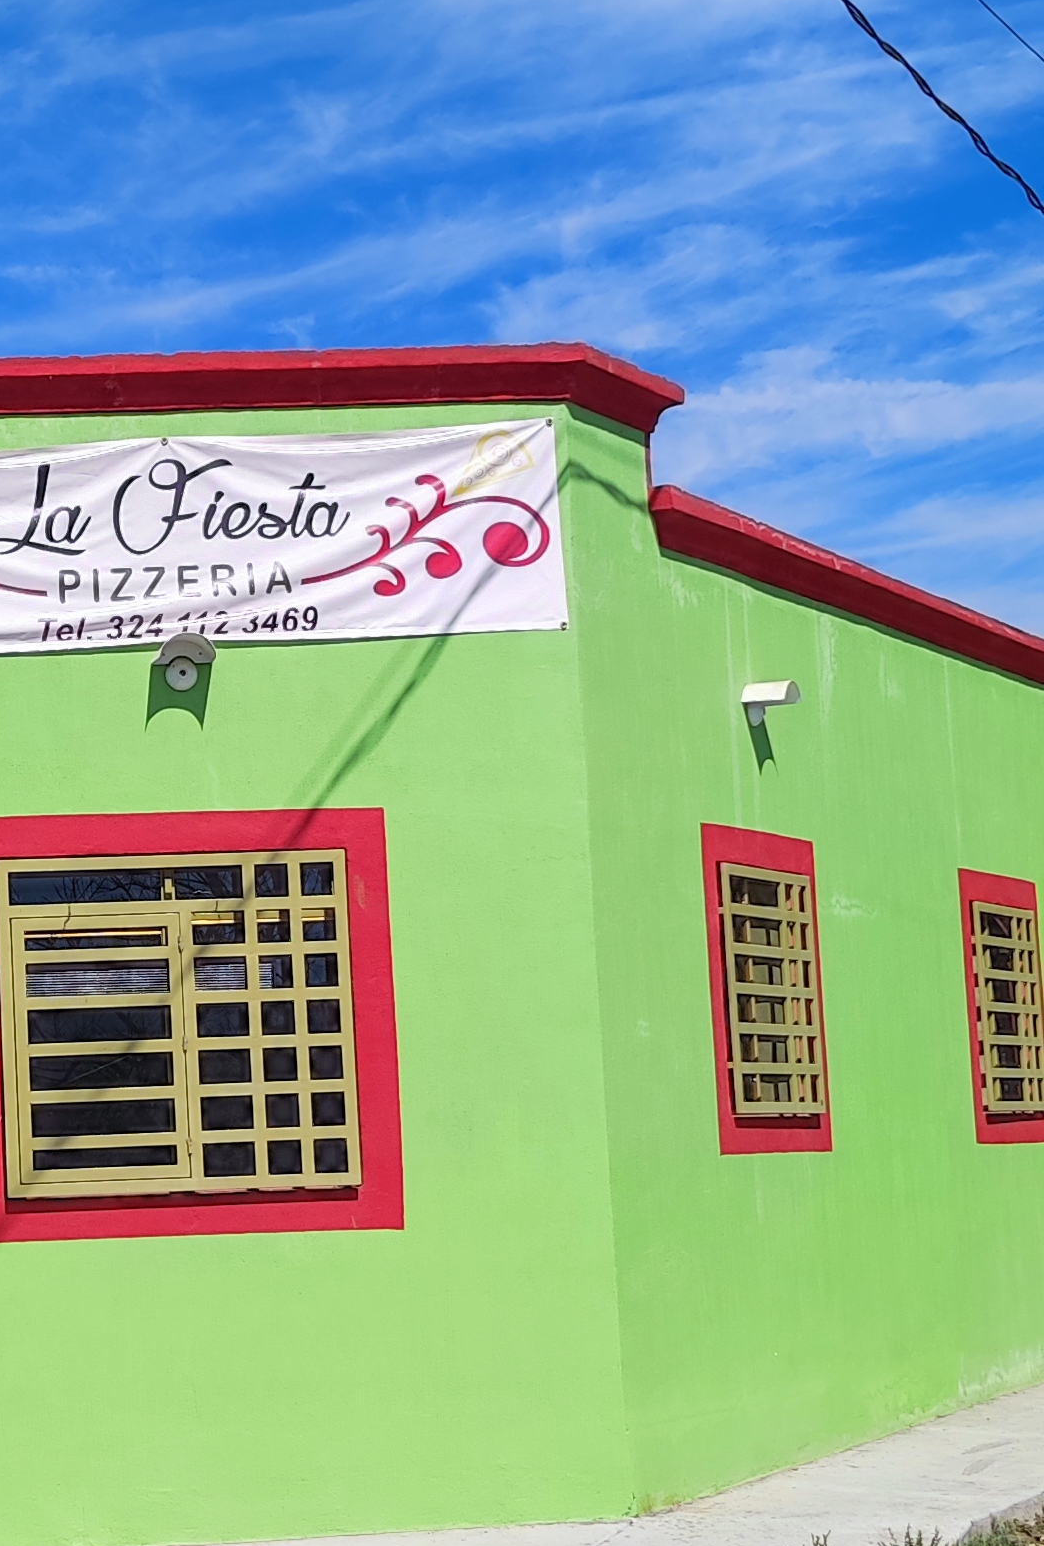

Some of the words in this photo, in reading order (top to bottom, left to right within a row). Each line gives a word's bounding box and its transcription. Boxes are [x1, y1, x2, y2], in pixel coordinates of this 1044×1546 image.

[112, 458, 351, 555] Fiesta
[56, 561, 295, 604] PIZZERIA
[38, 617, 94, 642] Tel.
[106, 613, 164, 640] 324
[241, 606, 319, 634] 3469
